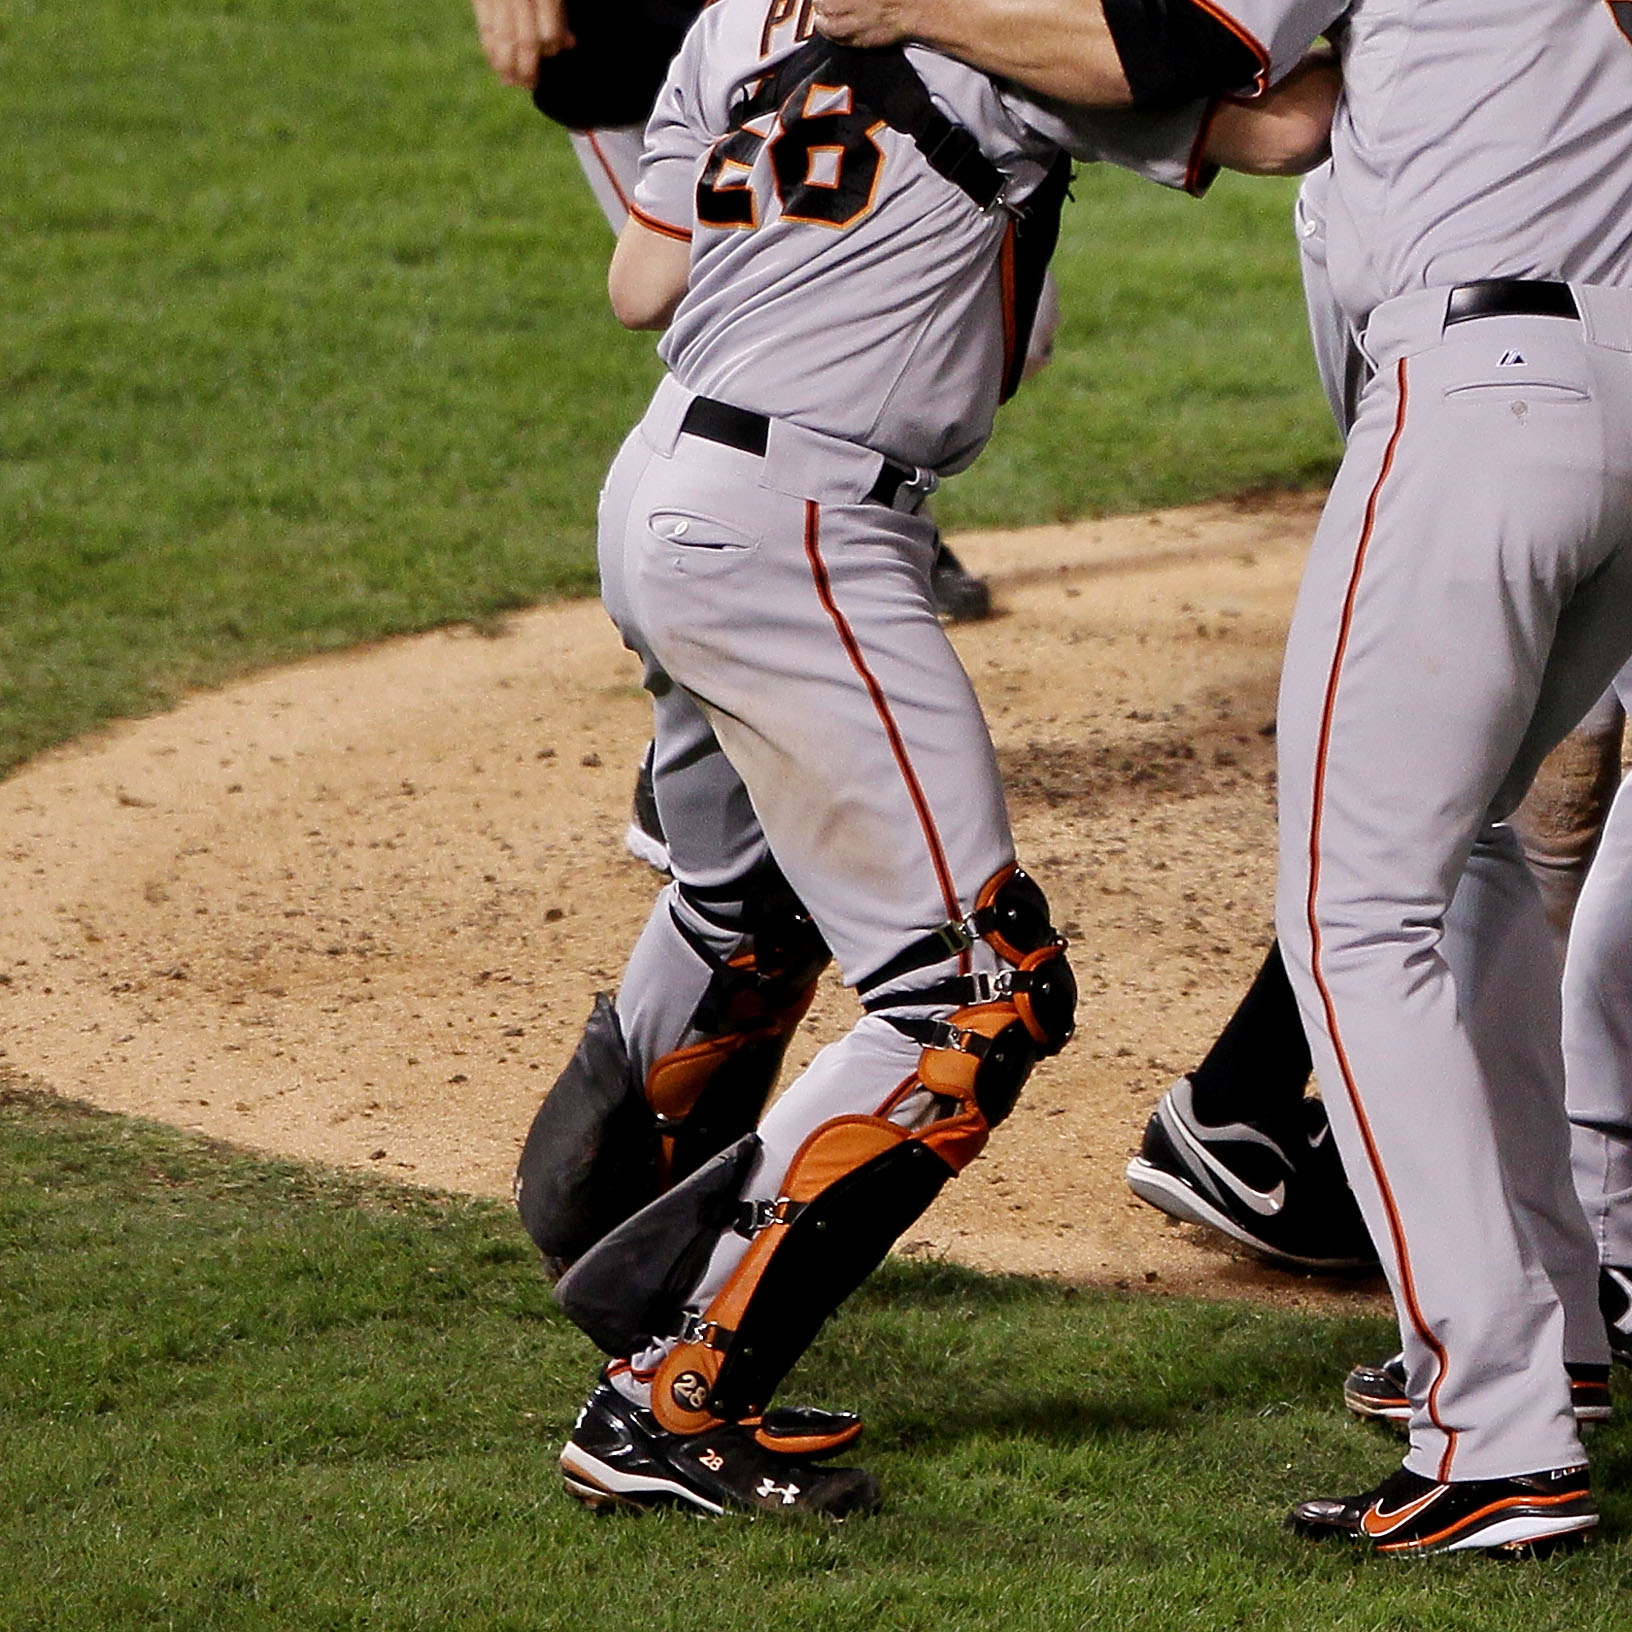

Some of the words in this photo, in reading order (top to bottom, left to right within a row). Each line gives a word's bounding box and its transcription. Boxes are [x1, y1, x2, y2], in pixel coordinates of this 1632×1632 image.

[696, 80, 886, 231] 28
[674, 1374, 707, 1408] 28
[699, 1448, 724, 1471] 28
